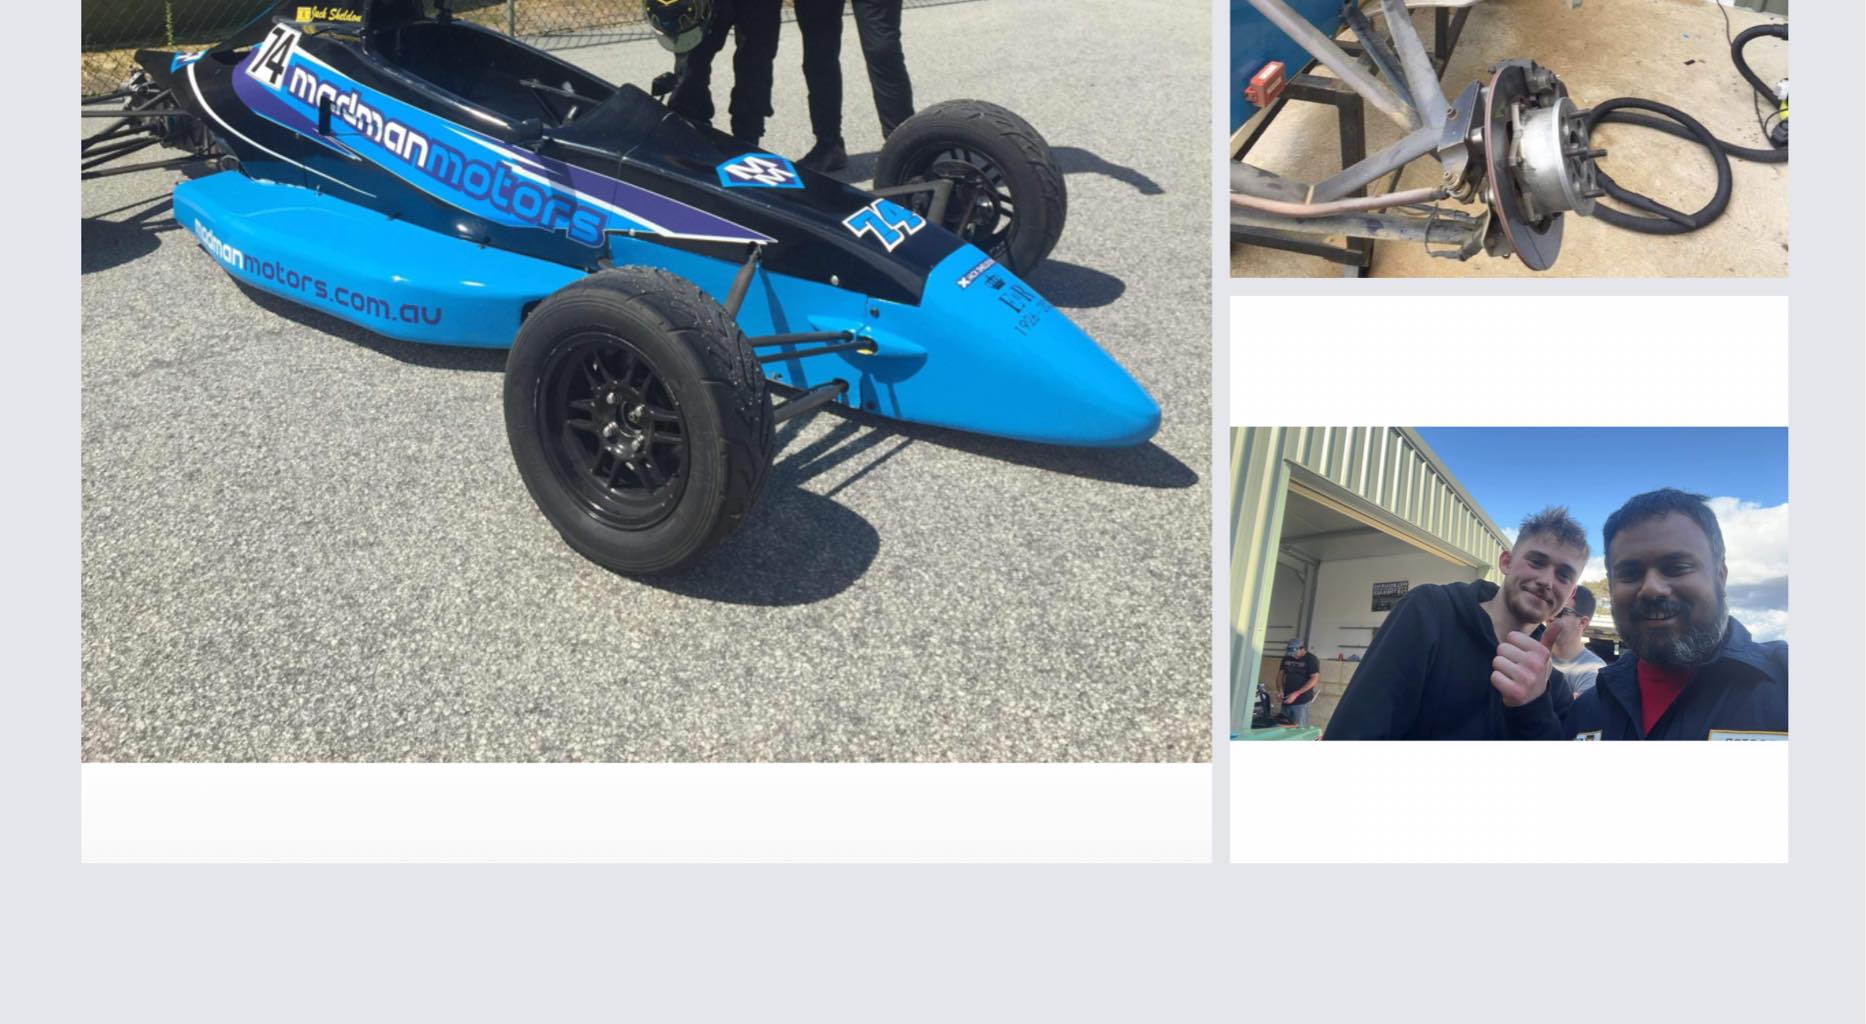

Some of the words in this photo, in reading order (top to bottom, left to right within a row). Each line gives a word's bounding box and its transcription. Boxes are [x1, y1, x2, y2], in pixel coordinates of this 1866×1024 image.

[311, 5, 328, 22] Jack
[328, 7, 362, 23] Sheldon
[251, 26, 297, 86] 74
[842, 198, 927, 252] 74
